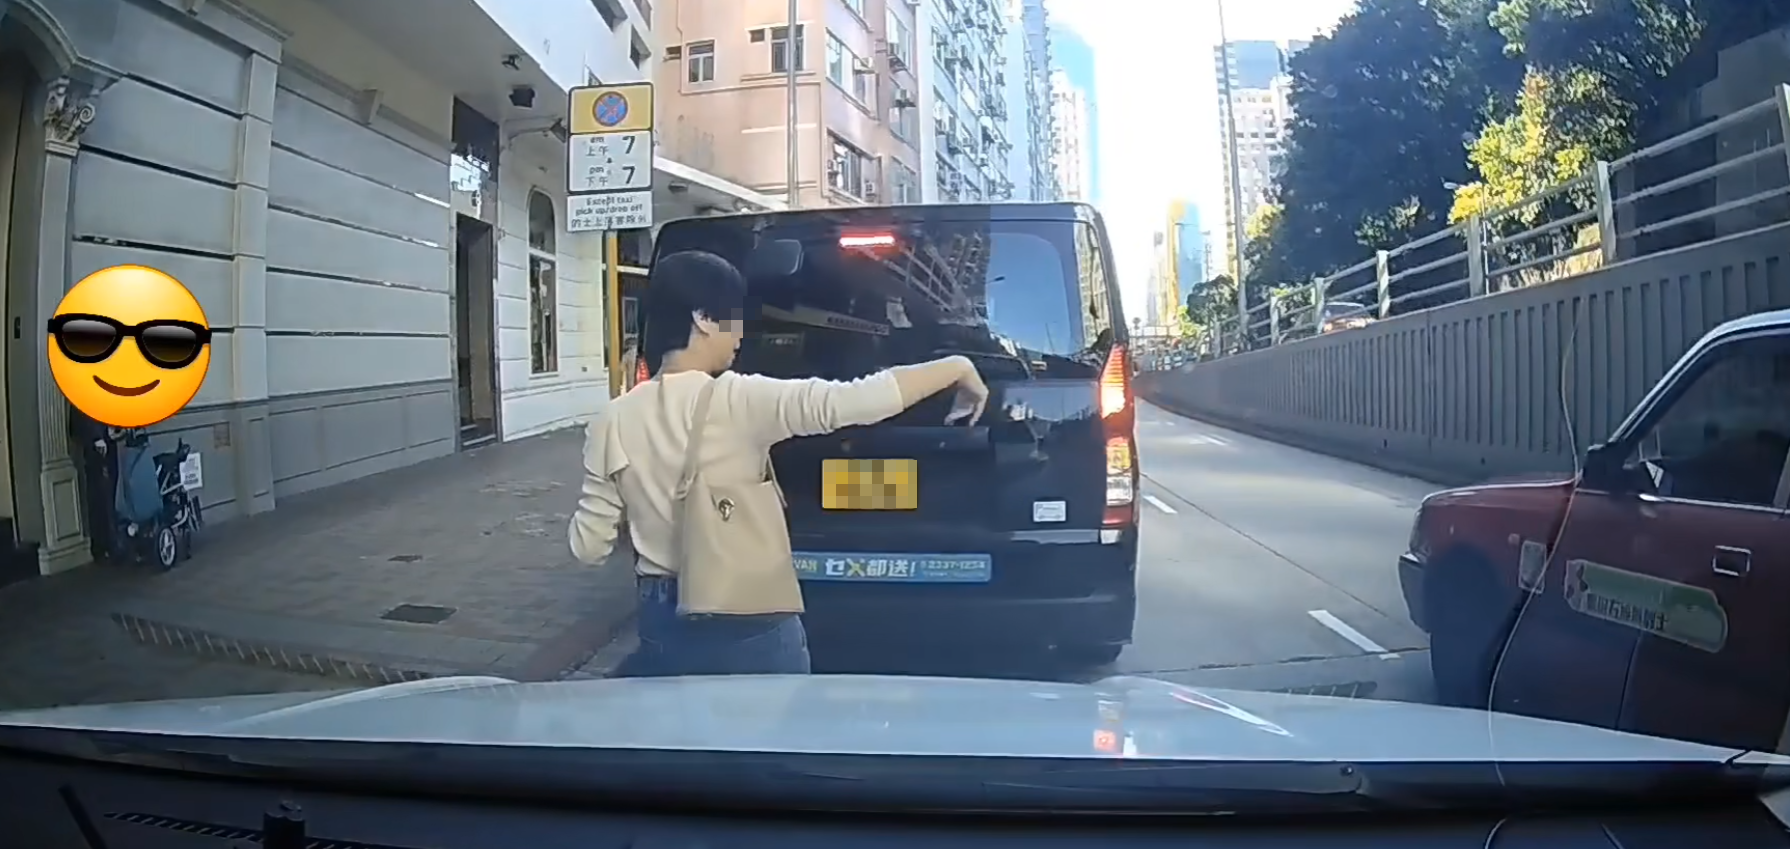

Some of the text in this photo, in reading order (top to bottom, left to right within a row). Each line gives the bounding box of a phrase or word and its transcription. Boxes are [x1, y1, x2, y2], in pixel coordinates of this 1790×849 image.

[585, 145, 609, 156] 上午
[622, 135, 636, 155] 7
[622, 165, 636, 184] 7
[585, 176, 609, 187] 下午
[586, 196, 615, 206] Except
[575, 203, 643, 217] pick up/drop off
